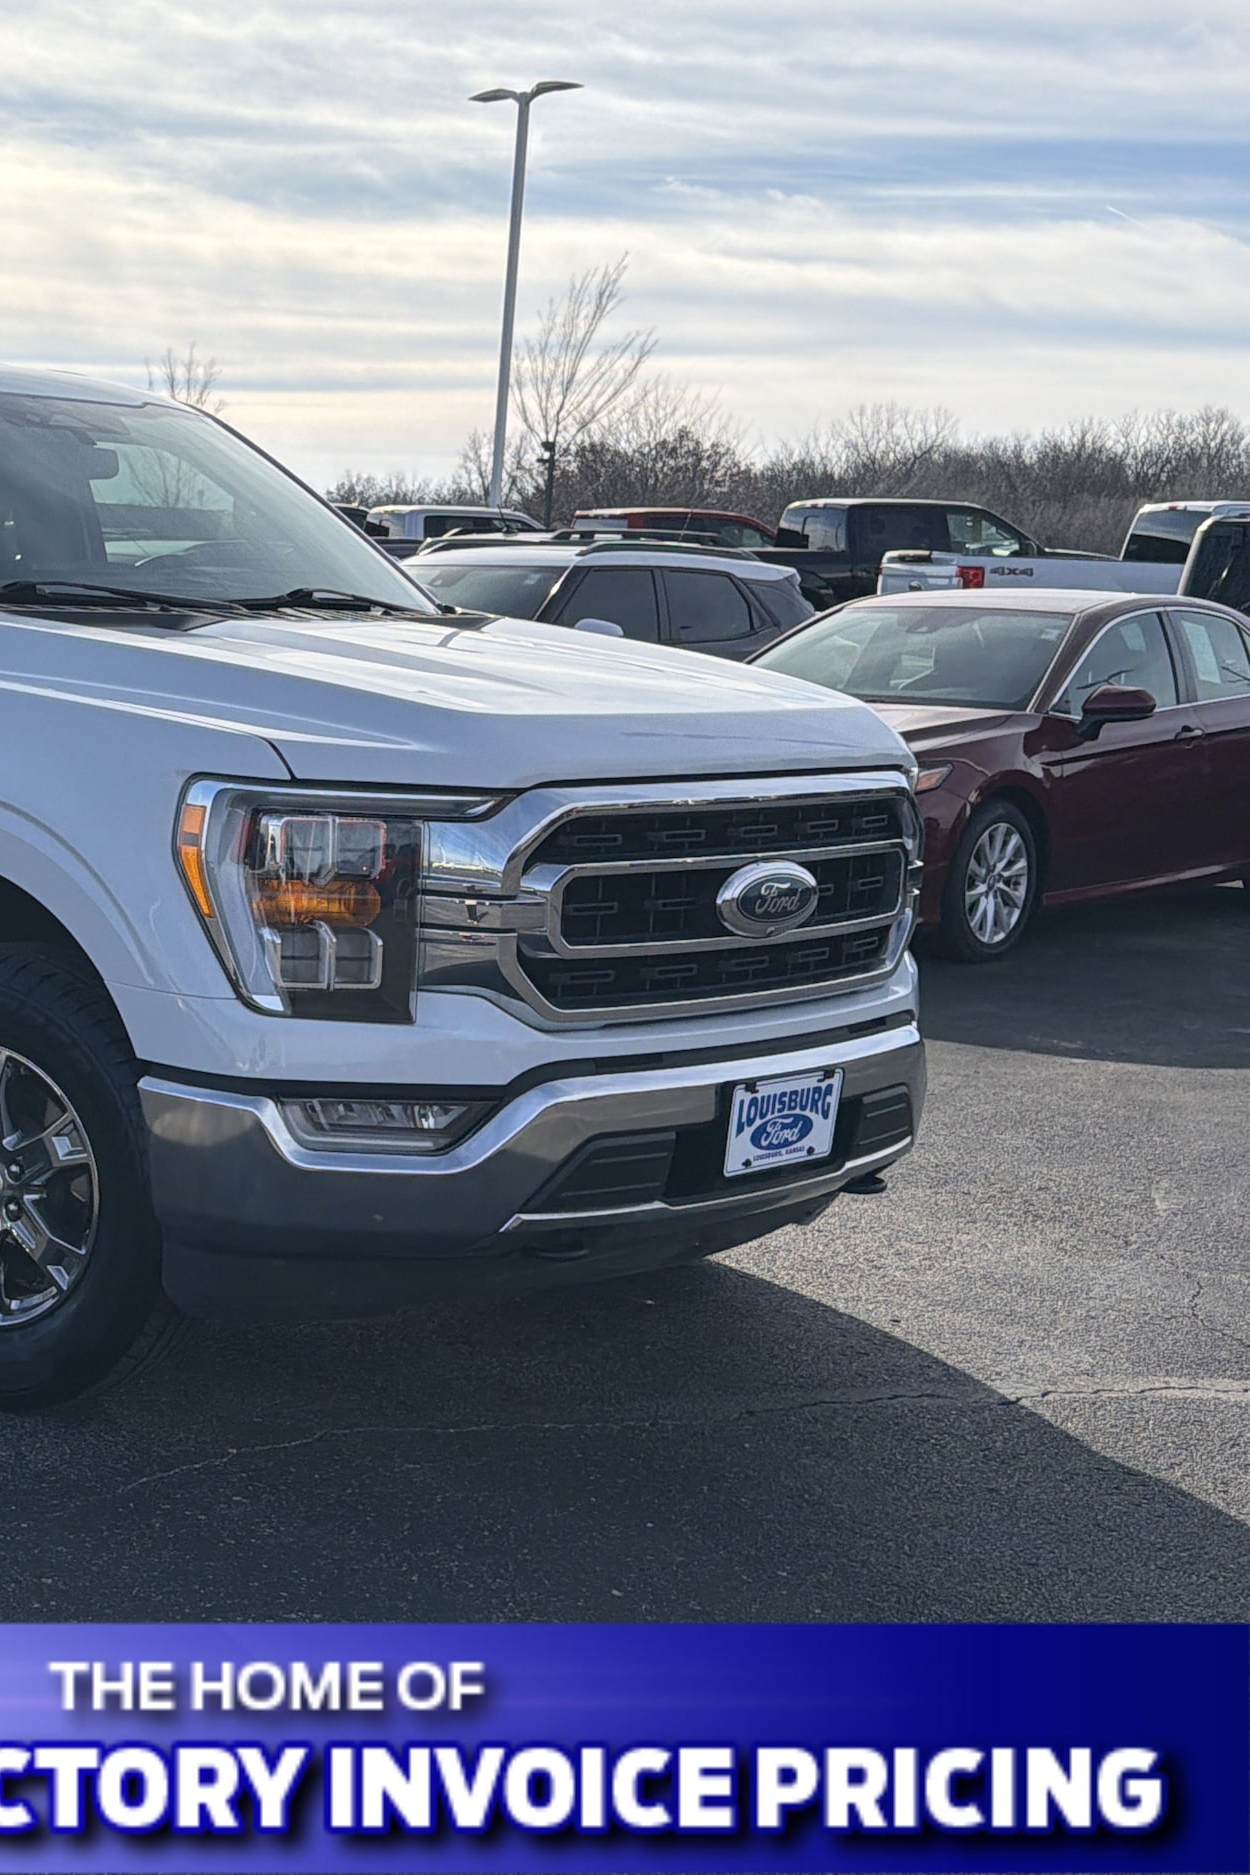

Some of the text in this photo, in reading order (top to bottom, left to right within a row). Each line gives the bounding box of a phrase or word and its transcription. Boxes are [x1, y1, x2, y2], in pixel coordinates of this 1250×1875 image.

[754, 882, 802, 915] Ford
[735, 1083, 834, 1138] LOUISBURG
[760, 1117, 804, 1147] Ford
